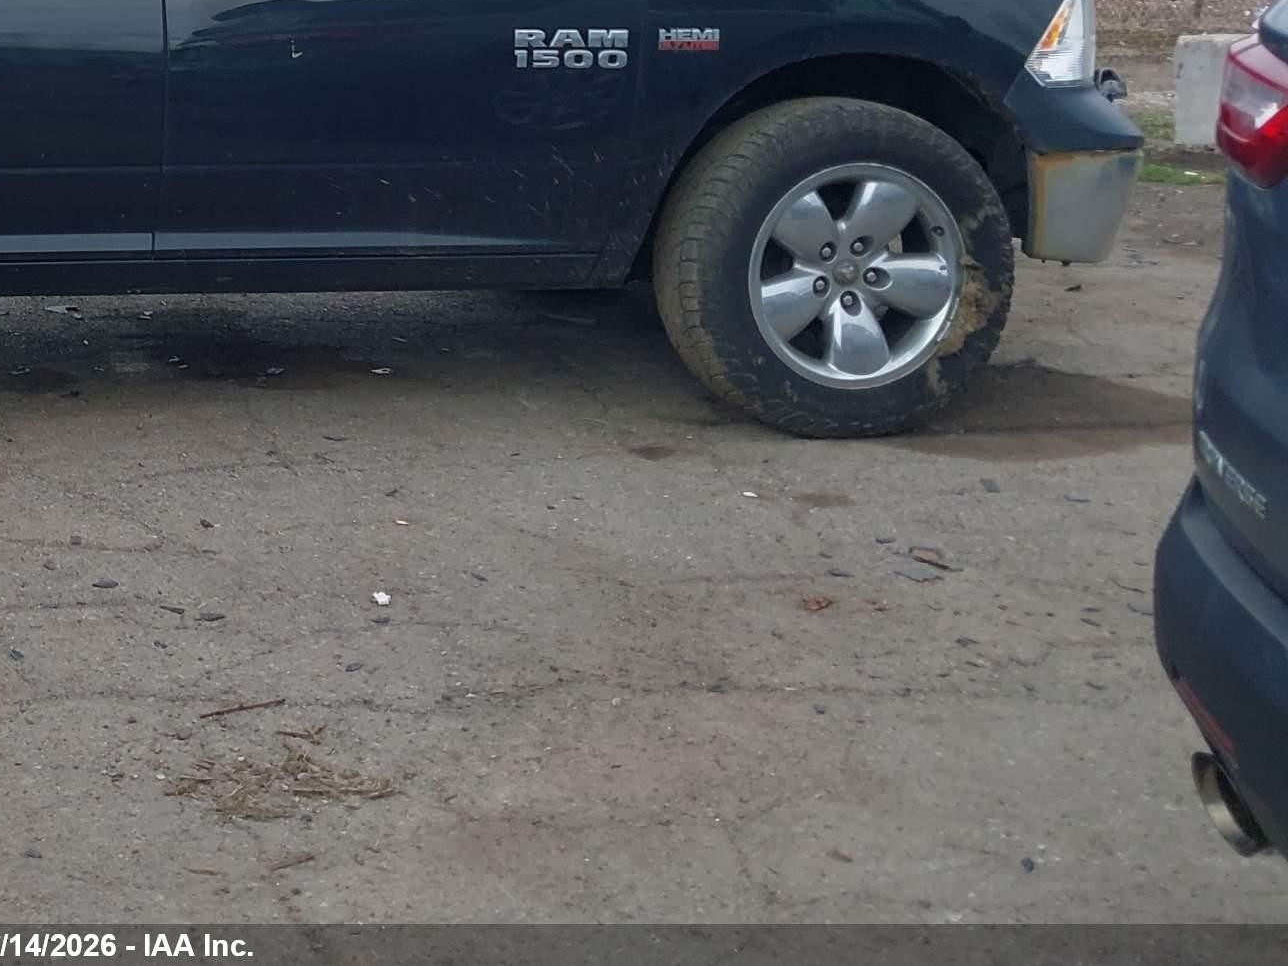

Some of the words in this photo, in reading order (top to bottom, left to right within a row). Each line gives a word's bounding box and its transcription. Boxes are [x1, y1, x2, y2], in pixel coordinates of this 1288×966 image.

[514, 29, 629, 48] RAM
[659, 28, 720, 42] HEMI
[514, 50, 629, 69] 1500
